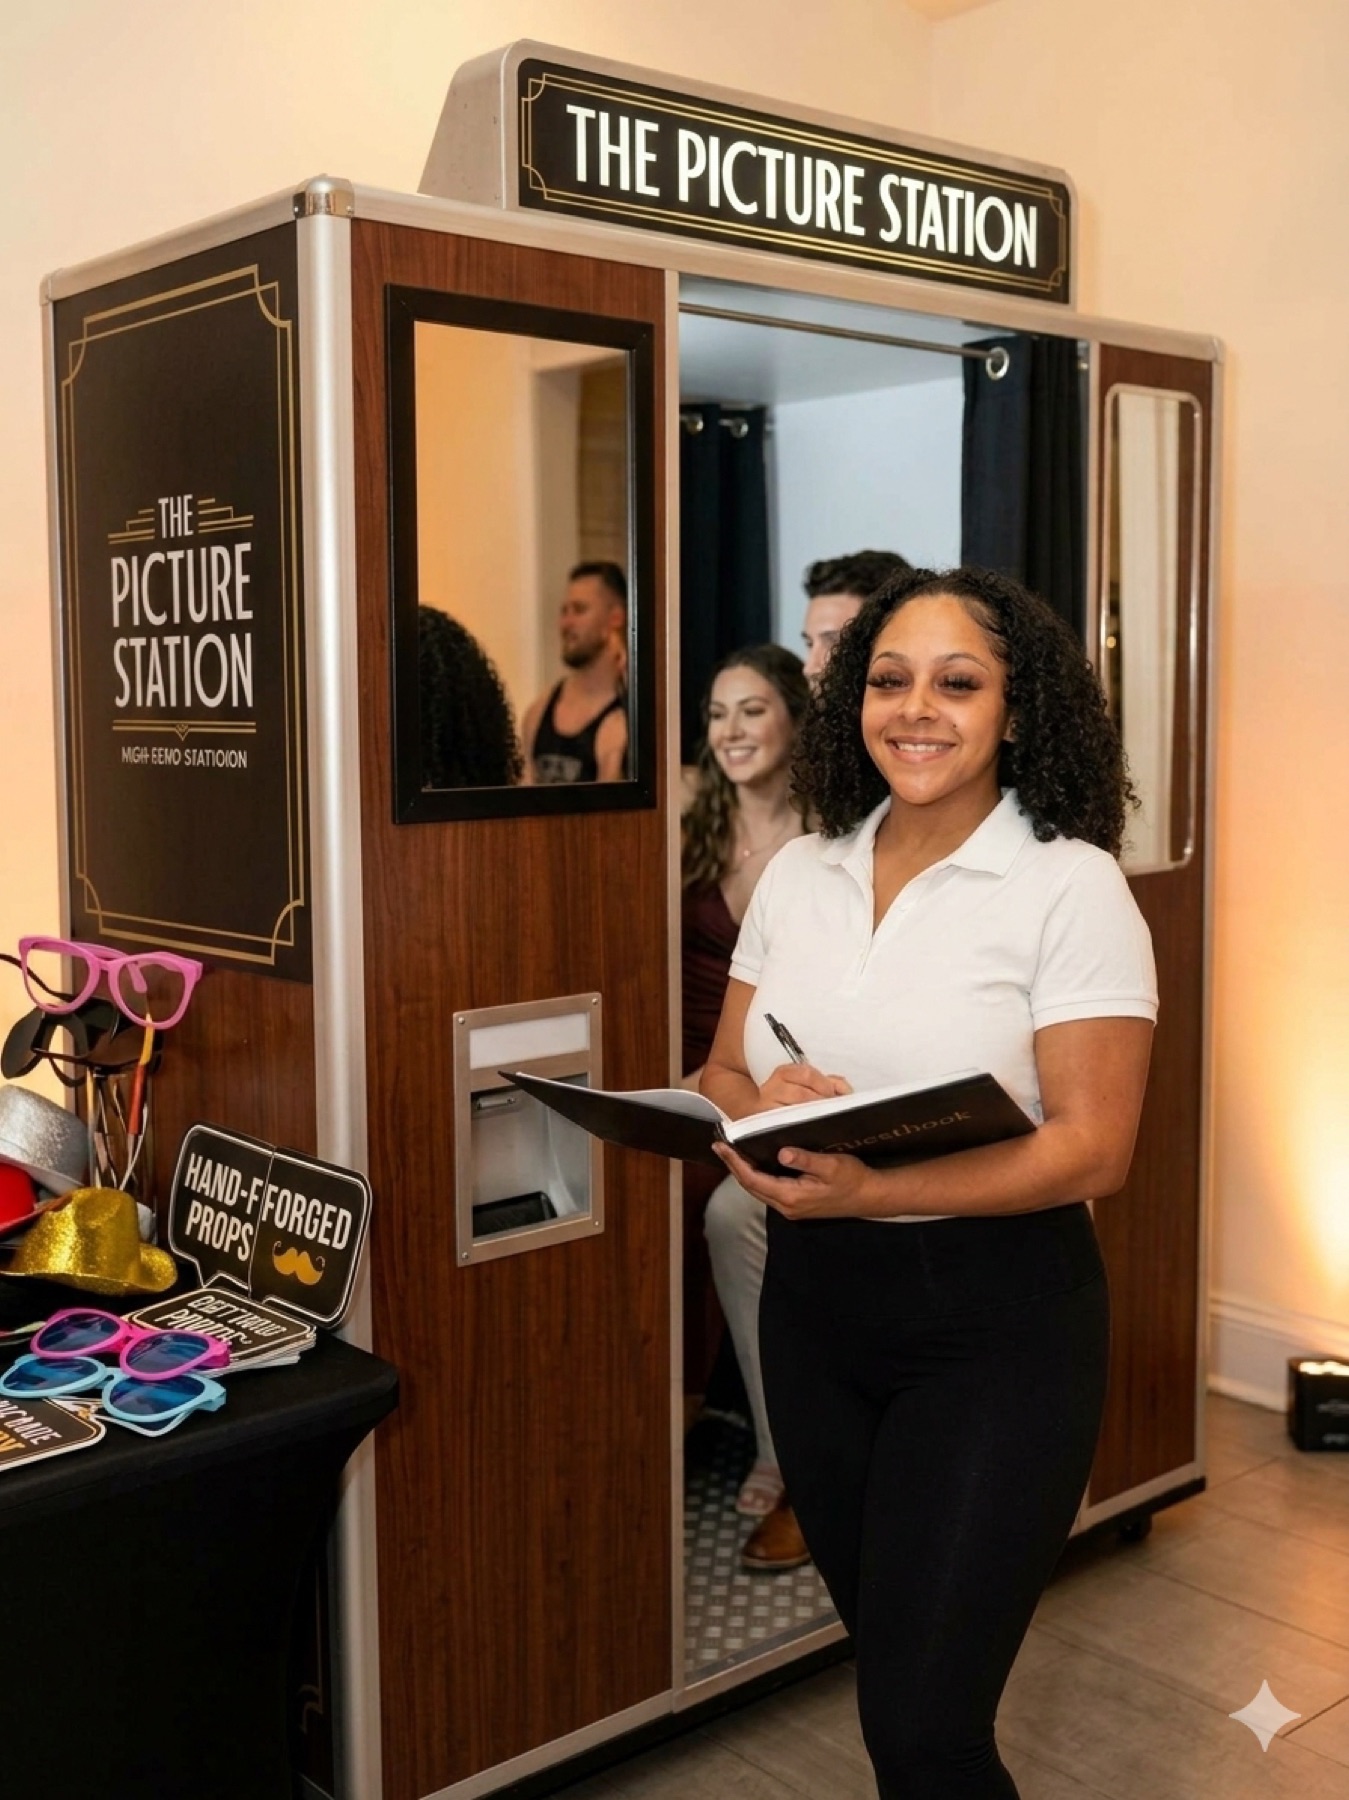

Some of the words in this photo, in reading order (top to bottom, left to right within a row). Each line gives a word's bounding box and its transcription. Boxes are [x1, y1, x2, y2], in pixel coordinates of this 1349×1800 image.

[566, 103, 660, 196] THE
[678, 128, 865, 236] PICTURE
[878, 173, 1037, 268] STATION
[158, 494, 194, 539] THE
[110, 541, 254, 628] PICTURE
[113, 632, 254, 708] STATION
[185, 1200, 254, 1262] PROPS
[261, 1183, 352, 1250] FORGED
